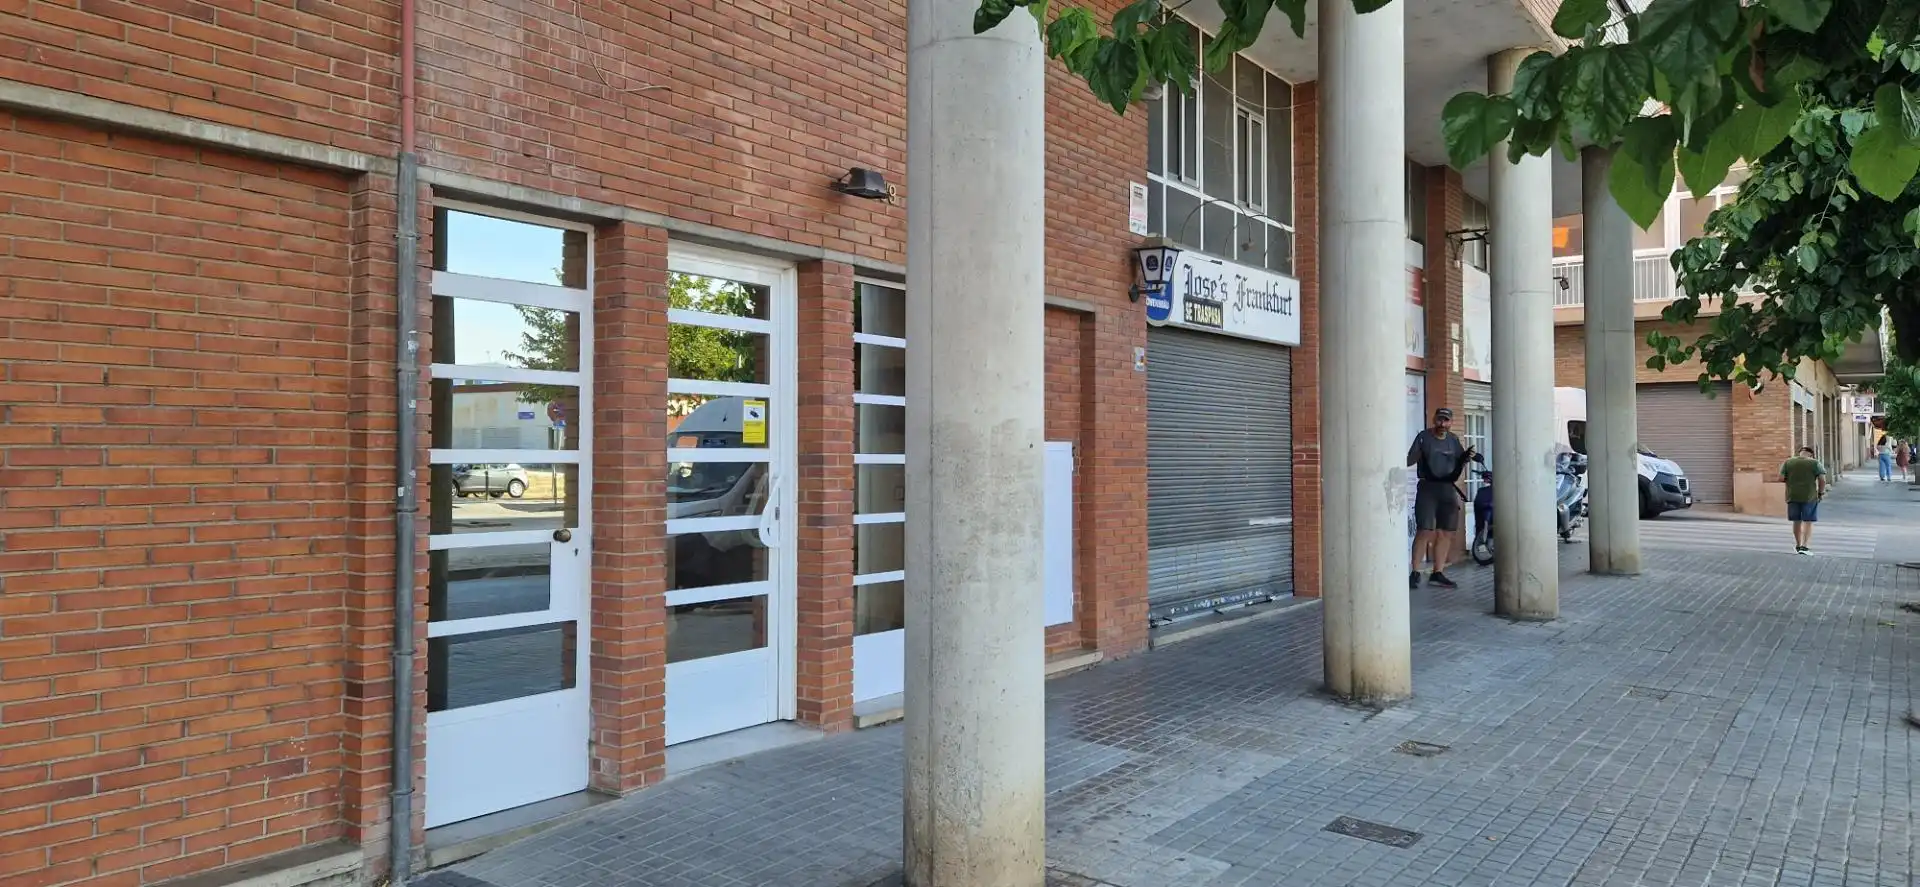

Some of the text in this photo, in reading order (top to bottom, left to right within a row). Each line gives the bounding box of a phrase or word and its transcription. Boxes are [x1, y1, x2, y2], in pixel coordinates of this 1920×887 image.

[1184, 263, 1292, 324] Jose's Frankfurt
[1185, 301, 1193, 320] SE
[1193, 303, 1221, 326] TRASPASA
